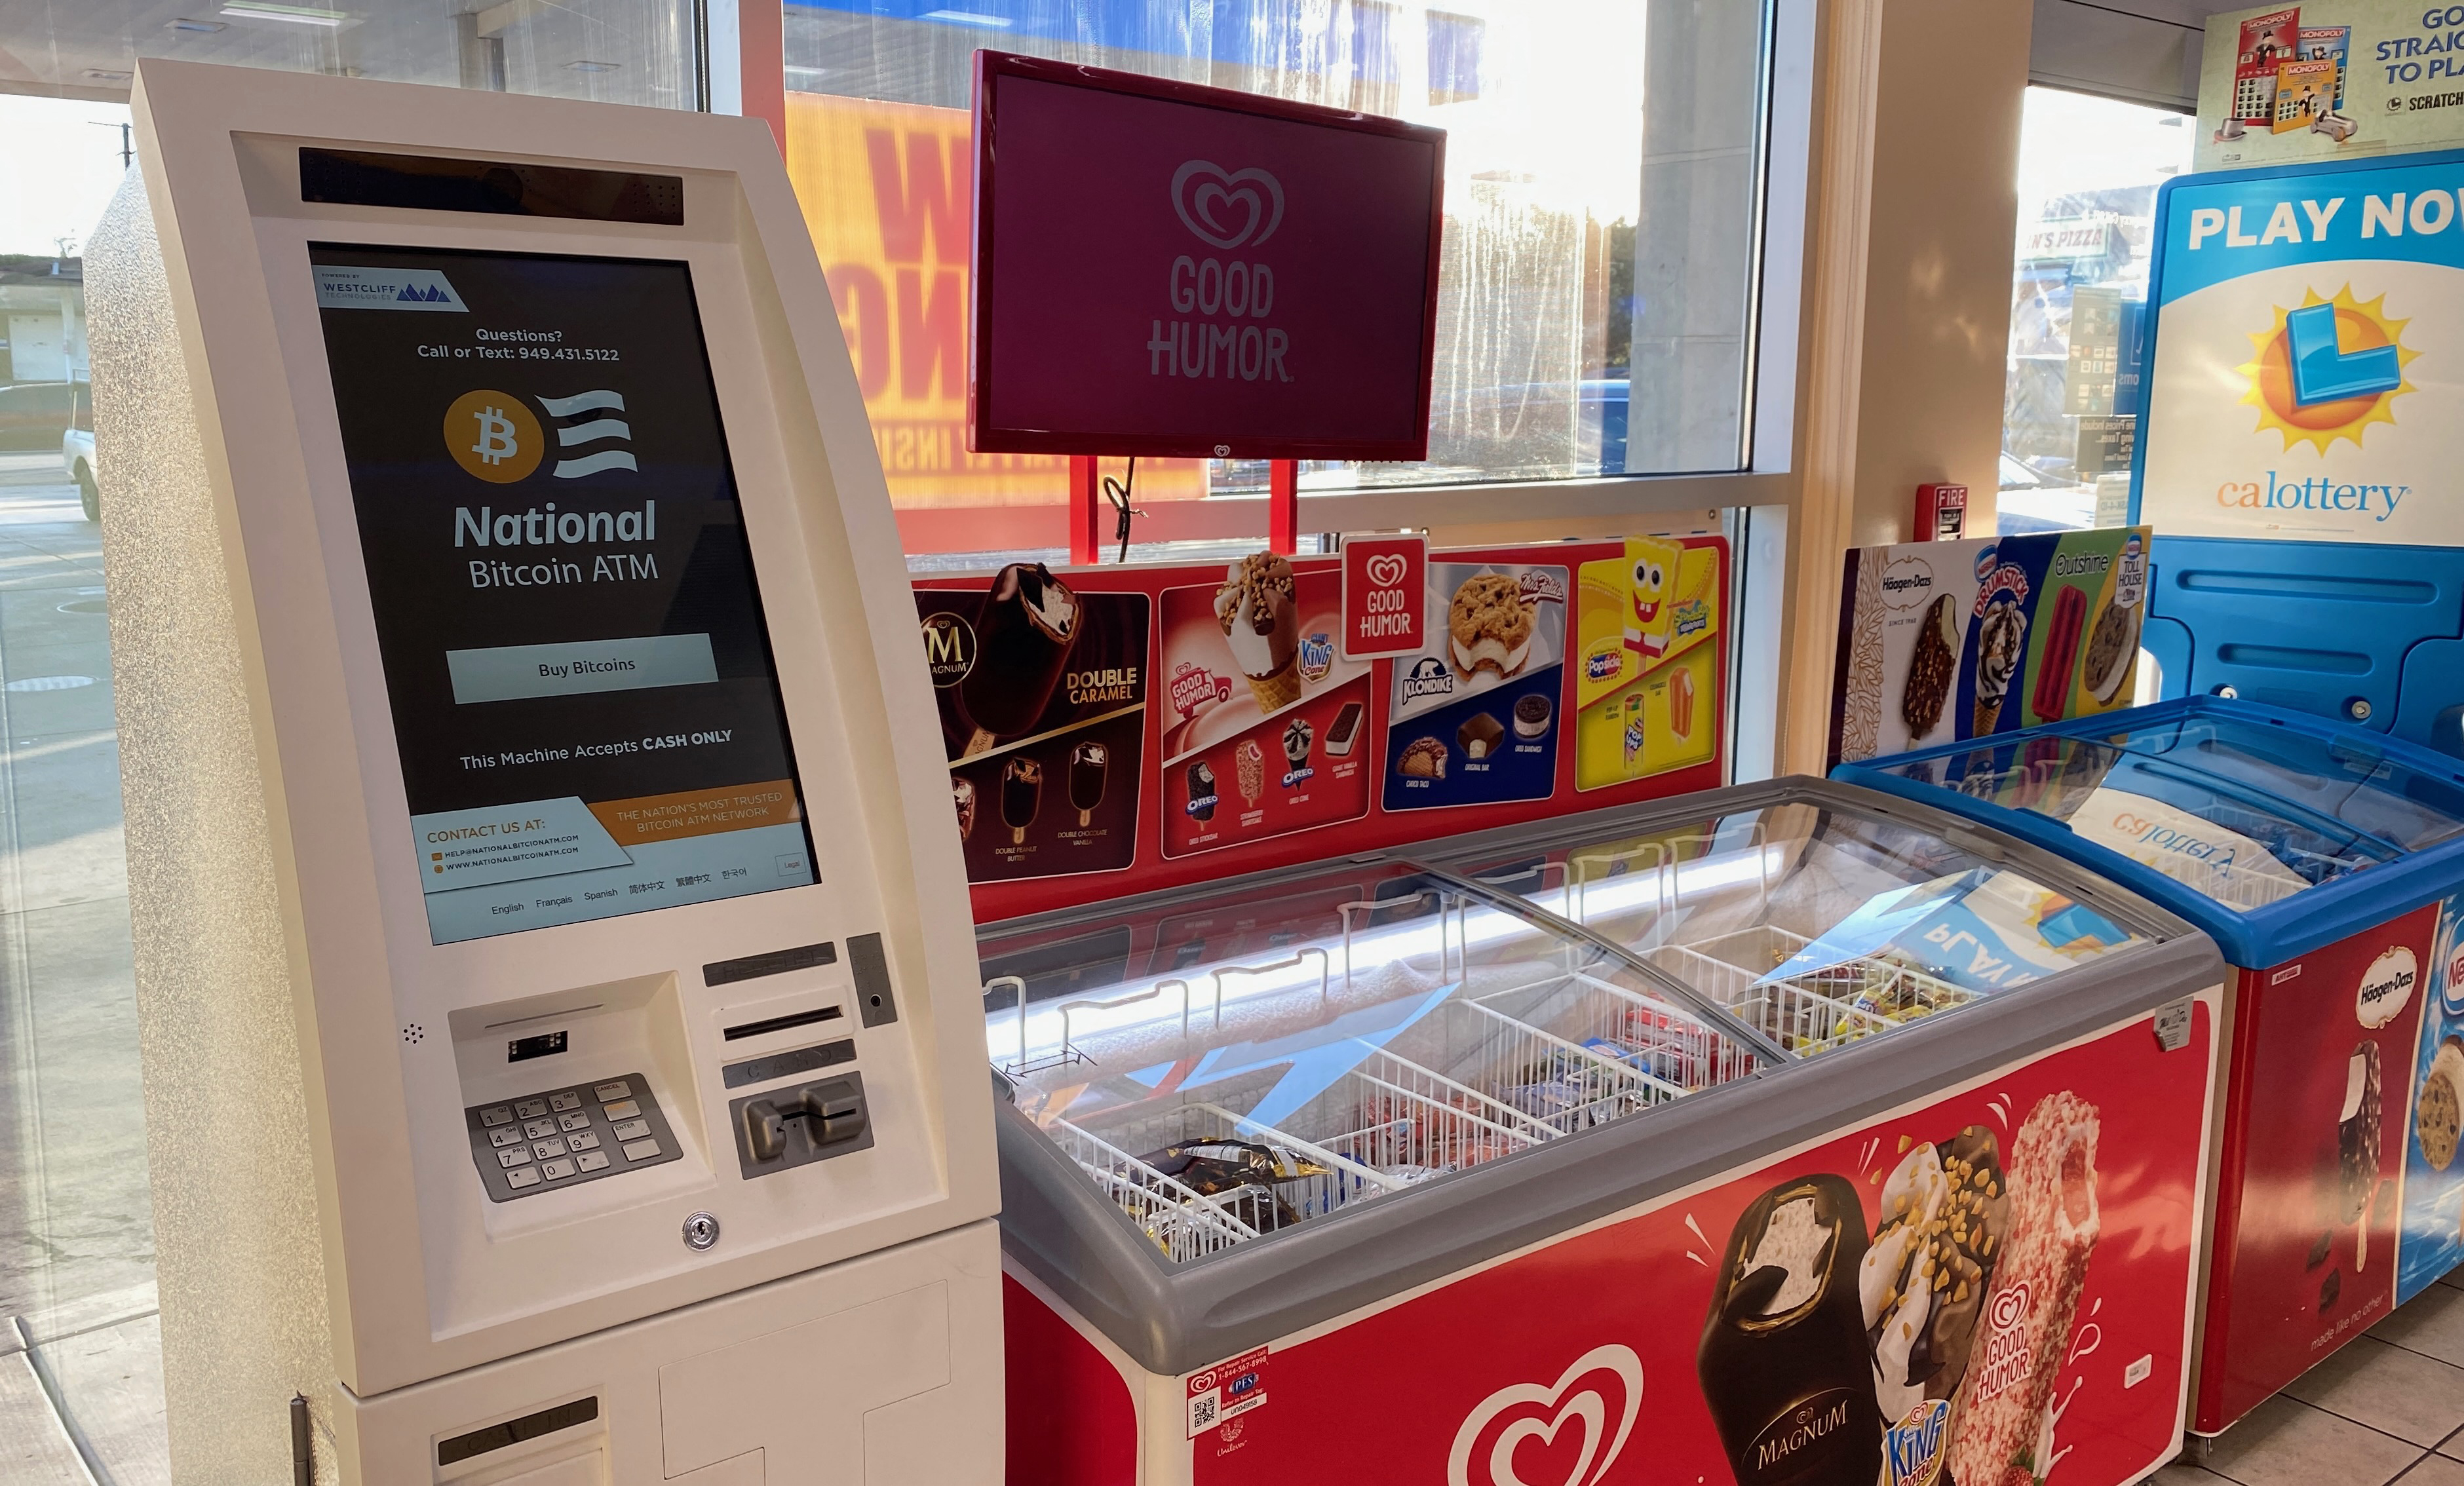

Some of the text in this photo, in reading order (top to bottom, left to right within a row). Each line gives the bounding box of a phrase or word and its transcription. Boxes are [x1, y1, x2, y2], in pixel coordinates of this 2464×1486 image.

[2249, 13, 2291, 29] MONOPOLY
[2422, 5, 2464, 29] GO
[2300, 29, 2344, 39] MONOPOLY
[2288, 64, 2330, 75] MONOPOLY
[2385, 62, 2422, 85] TO
[2189, 197, 2346, 250] PLAY
[2361, 188, 2464, 239] NO
[2056, 229, 2103, 248] PIZZA
[323, 282, 396, 294] WESTCLIFF
[1170, 255, 1274, 318] GOOD
[324, 292, 391, 301] TECHNOLOGIES
[476, 328, 562, 342] Questions?
[417, 345, 620, 361] Call or Text: 949.431.5122
[1147, 319, 1294, 382] HUMOR
[1938, 489, 1965, 506] FIRE
[2217, 471, 2408, 522] calottery
[454, 499, 655, 547] National
[469, 553, 659, 588] Bitcoin ATM
[2055, 552, 2109, 577] Outshine
[2125, 560, 2140, 574] TOLL
[1883, 574, 1931, 593] Häagen-Dazs
[2119, 573, 2142, 587] HOUSE
[1974, 567, 2029, 617] DRUMSTICK
[1367, 589, 1404, 613] GOOD
[1360, 613, 1412, 638] HUMOR
[539, 658, 636, 678] Buy Bitcoins
[931, 662, 967, 674] AGNUM
[1305, 666, 1324, 676] Cone
[1067, 668, 1137, 690] DOUBLE
[1172, 674, 1203, 698] GOOD
[1069, 685, 1132, 704] CARAMEL
[1176, 683, 1212, 711] HUMOR
[1402, 675, 1453, 706] KLONDIKE
[1628, 727, 1642, 740] POP
[460, 729, 733, 770] This Machine Accepts CASH ONLY
[1283, 768, 1314, 784] OREO
[616, 791, 782, 822] THE NATION'S MOST TRUSTED
[1187, 796, 1218, 812] OREO
[636, 807, 769, 833] BITCOIN ATM NETWORK
[427, 818, 546, 843] CONTACT US AT:
[446, 847, 579, 870] WWW.NATIONALBITCOINATM.COM
[995, 847, 1016, 855] DOUBLE
[784, 860, 800, 869] Legal
[722, 867, 747, 879] 한국어
[628, 880, 665, 895] 简体中文
[491, 888, 618, 915] English Français Spanish
[2360, 971, 2414, 1006] Häagen-Dazs
[595, 1083, 620, 1092] CANCEL
[520, 1107, 530, 1117] 2
[555, 1100, 564, 1109] 3
[486, 1115, 493, 1124] 1
[564, 1120, 573, 1129] 6
[615, 1122, 635, 1131] ENTER
[495, 1135, 504, 1144] 4
[529, 1127, 539, 1137] 5
[539, 1147, 547, 1156] 8
[573, 1139, 582, 1148] 9
[503, 1154, 511, 1164] 7
[547, 1166, 556, 1175] 0
[2311, 1294, 2383, 1352] made like no other
[1986, 1325, 2026, 1367] GOOD
[1226, 1360, 1240, 1370] Repair
[1241, 1354, 1256, 1363] Service
[1978, 1348, 2031, 1403] HUMOR
[1756, 1400, 1847, 1470] MAGNUM
[1217, 1441, 1245, 1457] Unilever
